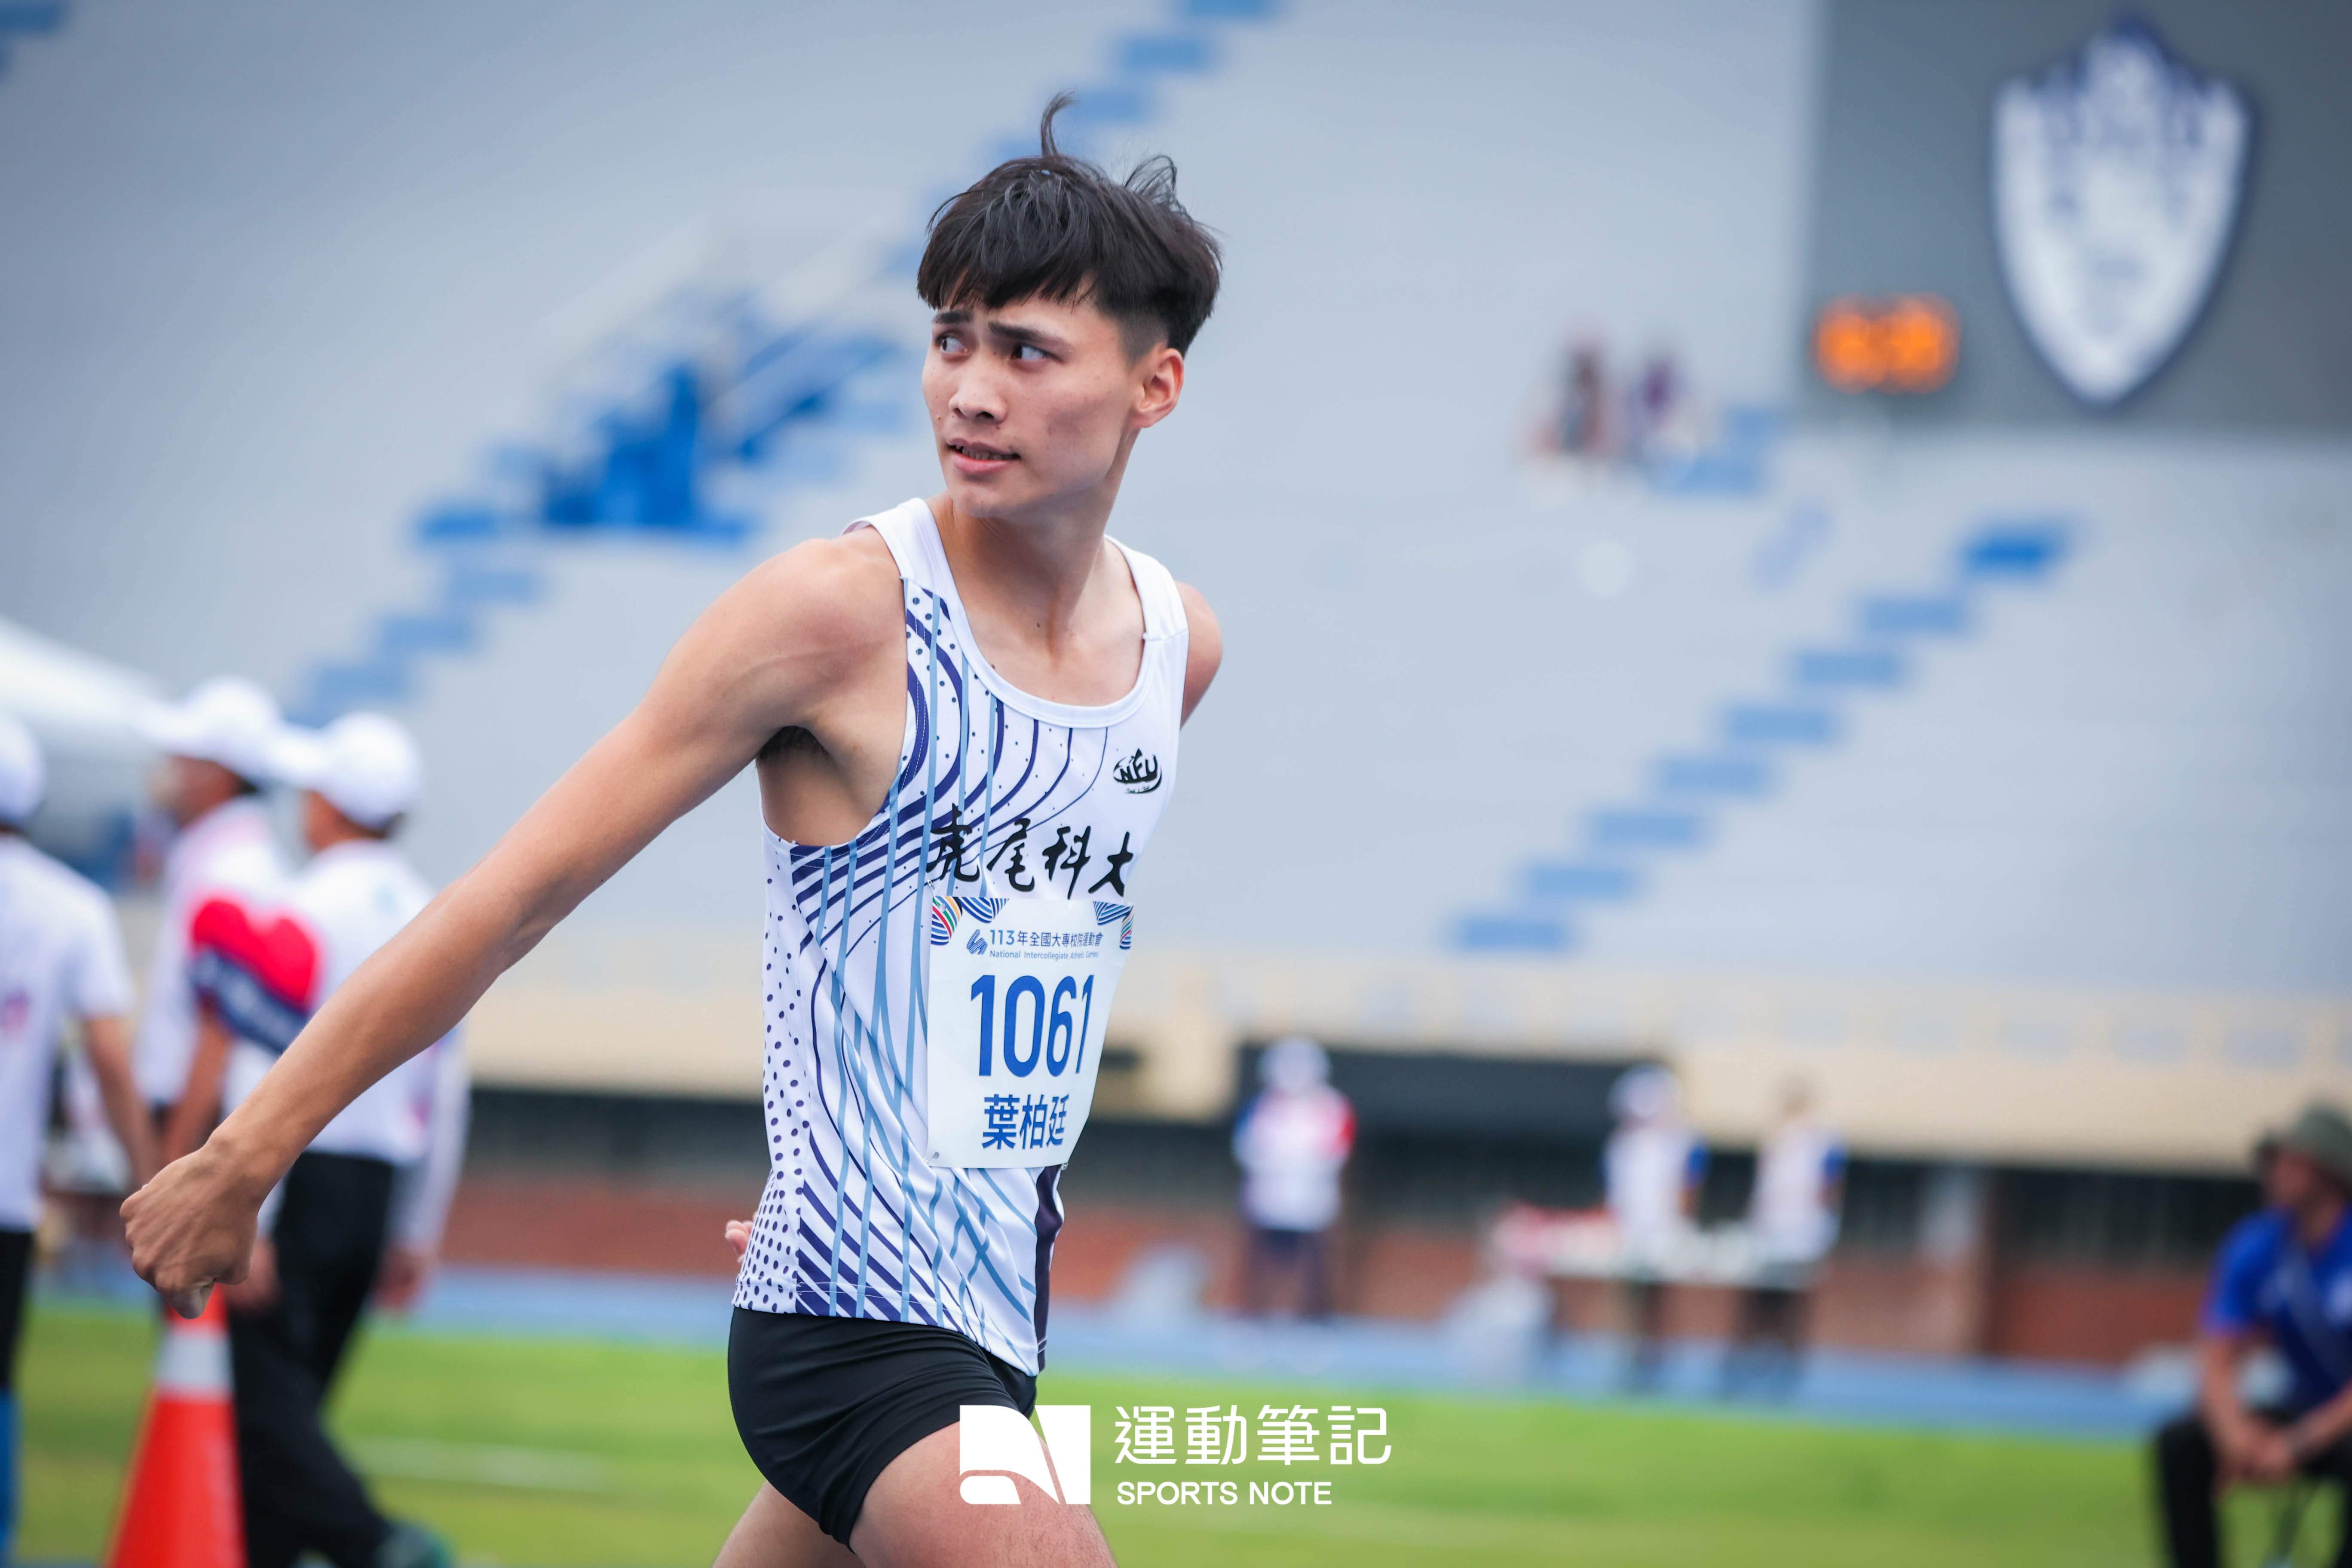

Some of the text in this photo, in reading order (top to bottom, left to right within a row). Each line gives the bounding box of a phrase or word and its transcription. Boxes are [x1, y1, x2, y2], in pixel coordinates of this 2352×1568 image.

[1119, 748, 1158, 783] NFU
[926, 803, 1134, 900] 虎尾科大
[990, 929, 1104, 947] 113年全國大專校院運動會
[990, 950, 1020, 959] National
[1024, 951, 1069, 961] Intercollegiate
[1070, 951, 1084, 959] Athletic
[971, 974, 1094, 1078] 1061
[981, 1093, 1070, 1150] 葉柏廷
